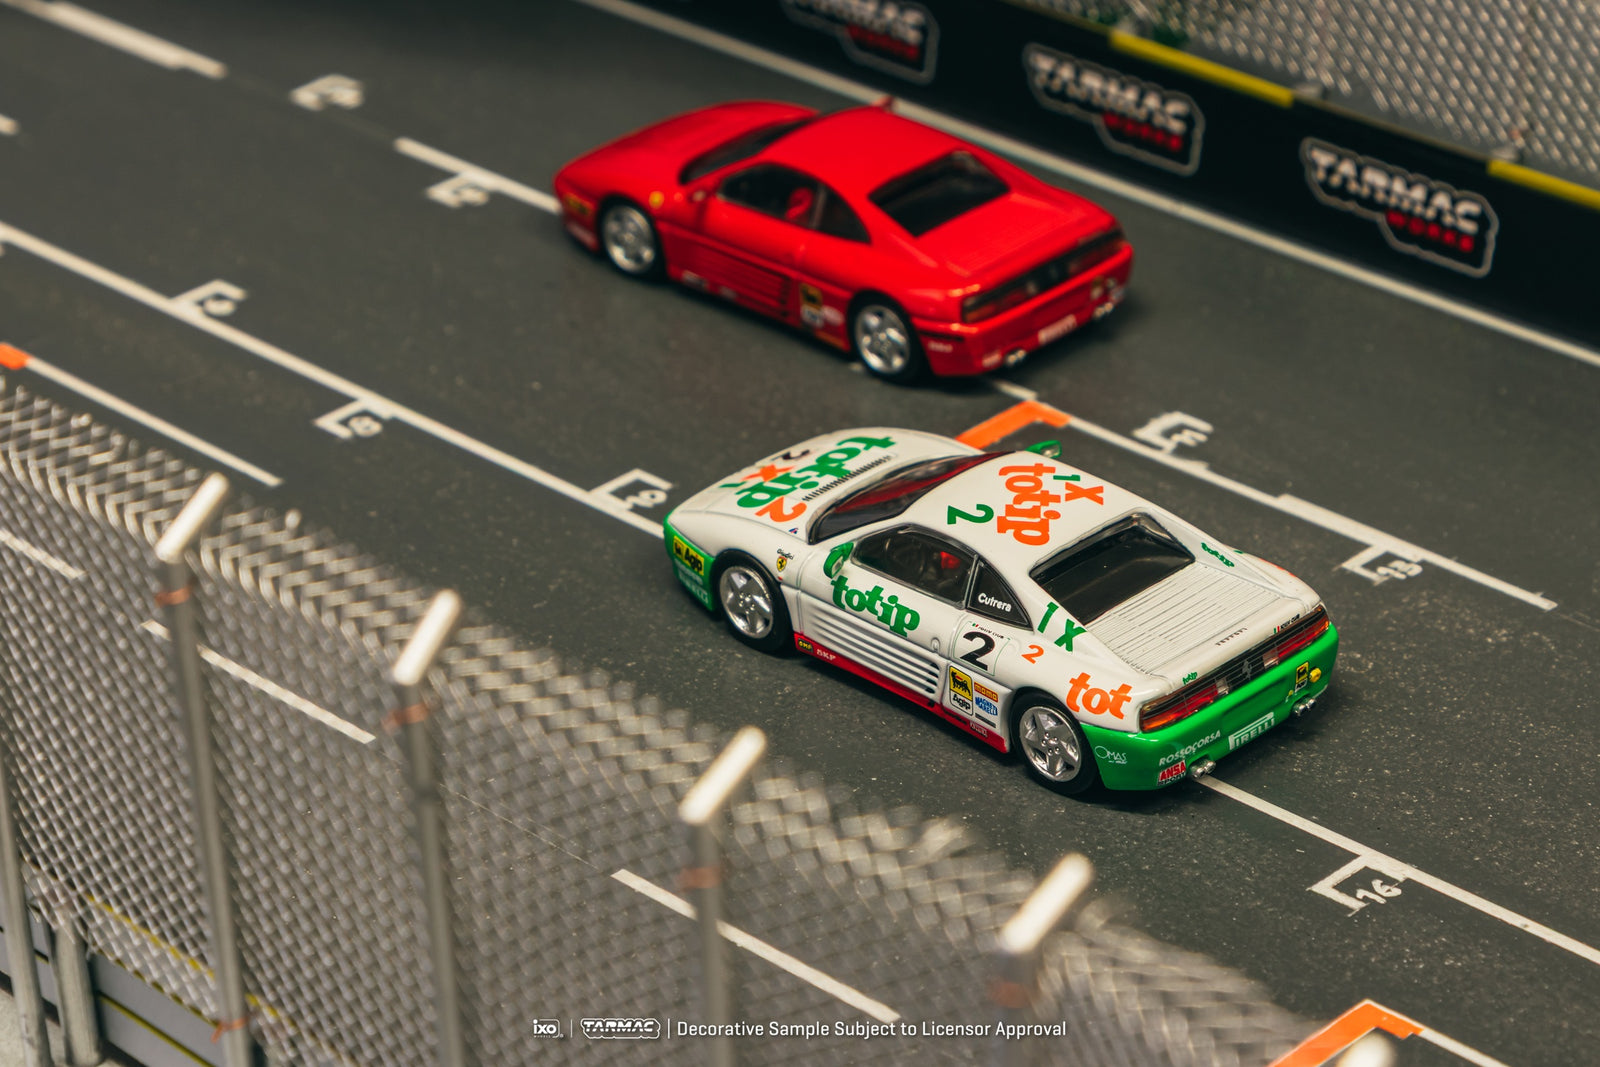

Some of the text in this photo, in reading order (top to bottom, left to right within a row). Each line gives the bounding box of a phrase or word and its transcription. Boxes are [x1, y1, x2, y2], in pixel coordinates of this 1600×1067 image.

[1310, 147, 1483, 235] TARMAC
[946, 504, 994, 525] 2
[997, 463, 1061, 546] totip
[830, 575, 920, 637] totip
[978, 592, 1012, 612] Cutrera
[960, 631, 995, 671] 2
[1021, 644, 1044, 664] 2
[1066, 672, 1133, 720] tot
[1228, 711, 1275, 750] PIRELLI
[1094, 745, 1127, 761] OMAS
[1159, 760, 1186, 781] ANSA
[1356, 879, 1402, 904] 16
